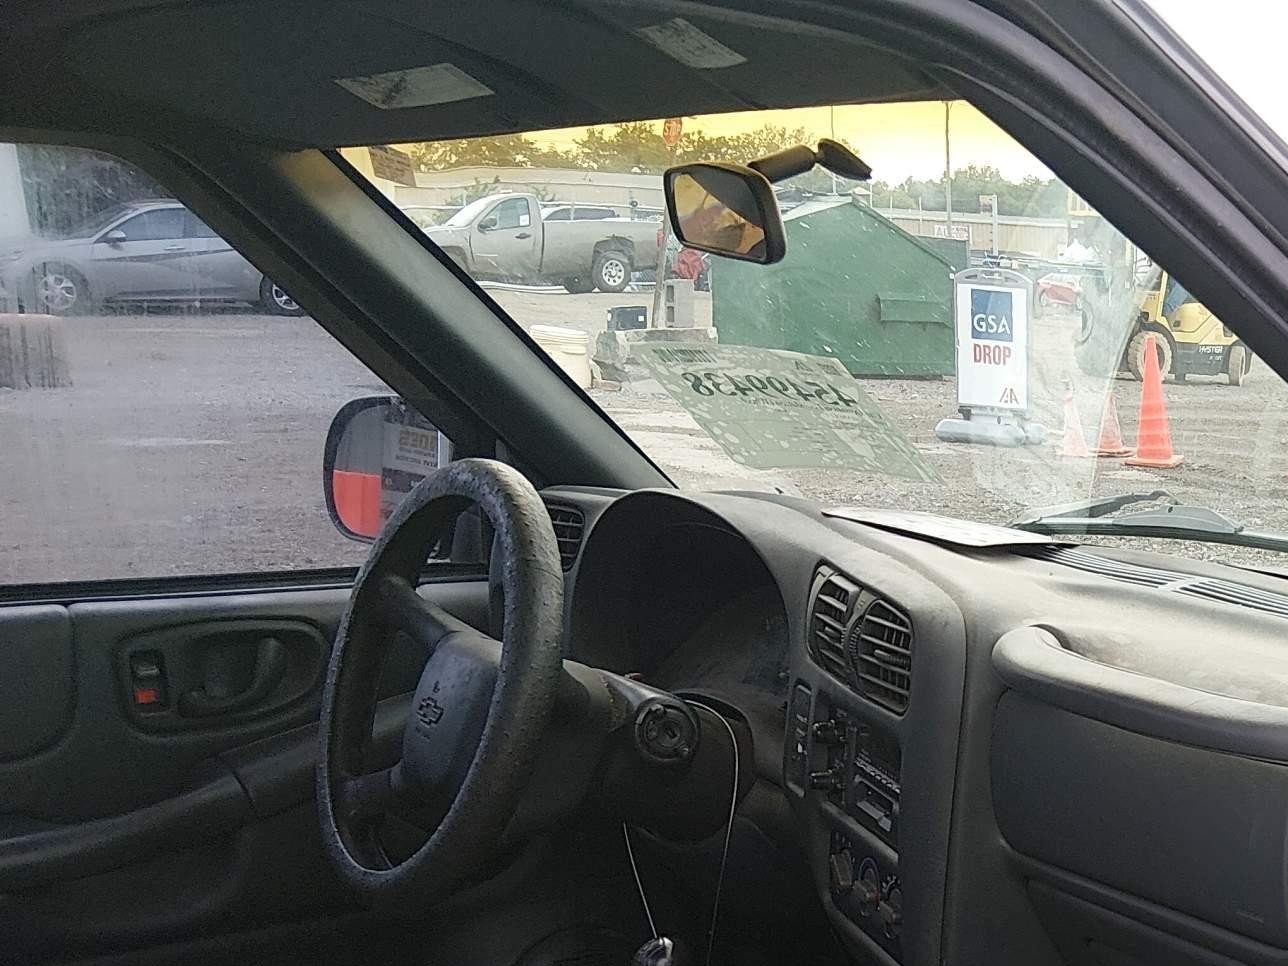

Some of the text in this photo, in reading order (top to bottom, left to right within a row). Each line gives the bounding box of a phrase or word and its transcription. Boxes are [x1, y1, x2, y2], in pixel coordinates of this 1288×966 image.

[973, 313, 1011, 334] GSA
[973, 343, 1012, 366] DROP
[1198, 345, 1223, 354] HYSTER
